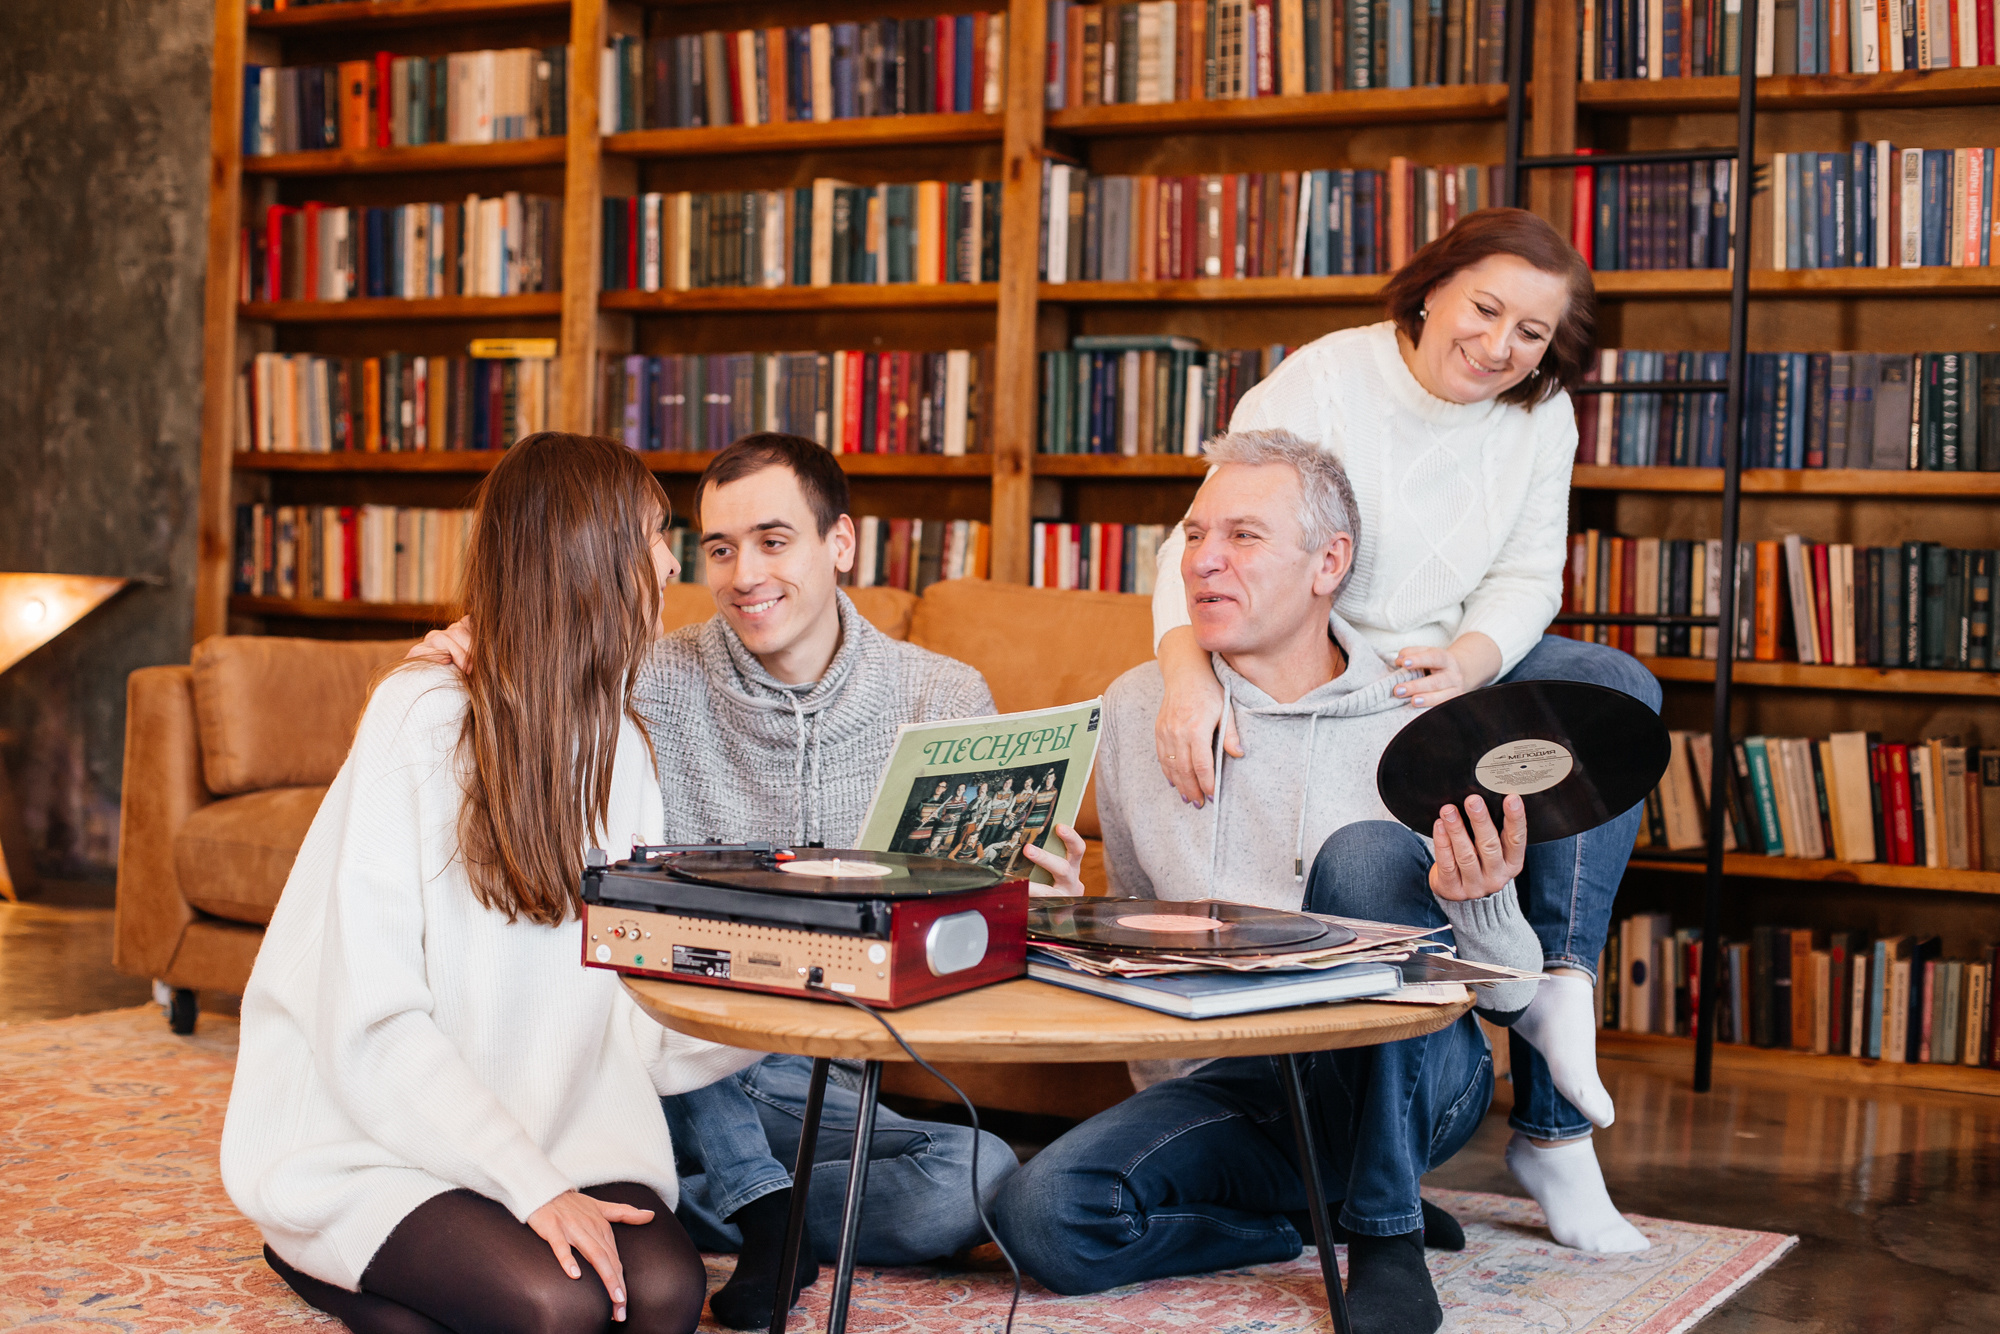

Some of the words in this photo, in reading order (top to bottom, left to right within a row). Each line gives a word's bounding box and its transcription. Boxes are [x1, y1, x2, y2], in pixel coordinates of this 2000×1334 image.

[1867, 44, 1875, 62] 2
[1969, 156, 1980, 193] ГАЙДАР
[923, 723, 1079, 767] ПЕСНЯРЫ
[1508, 749, 1556, 760] МЕЛОДИЯ
